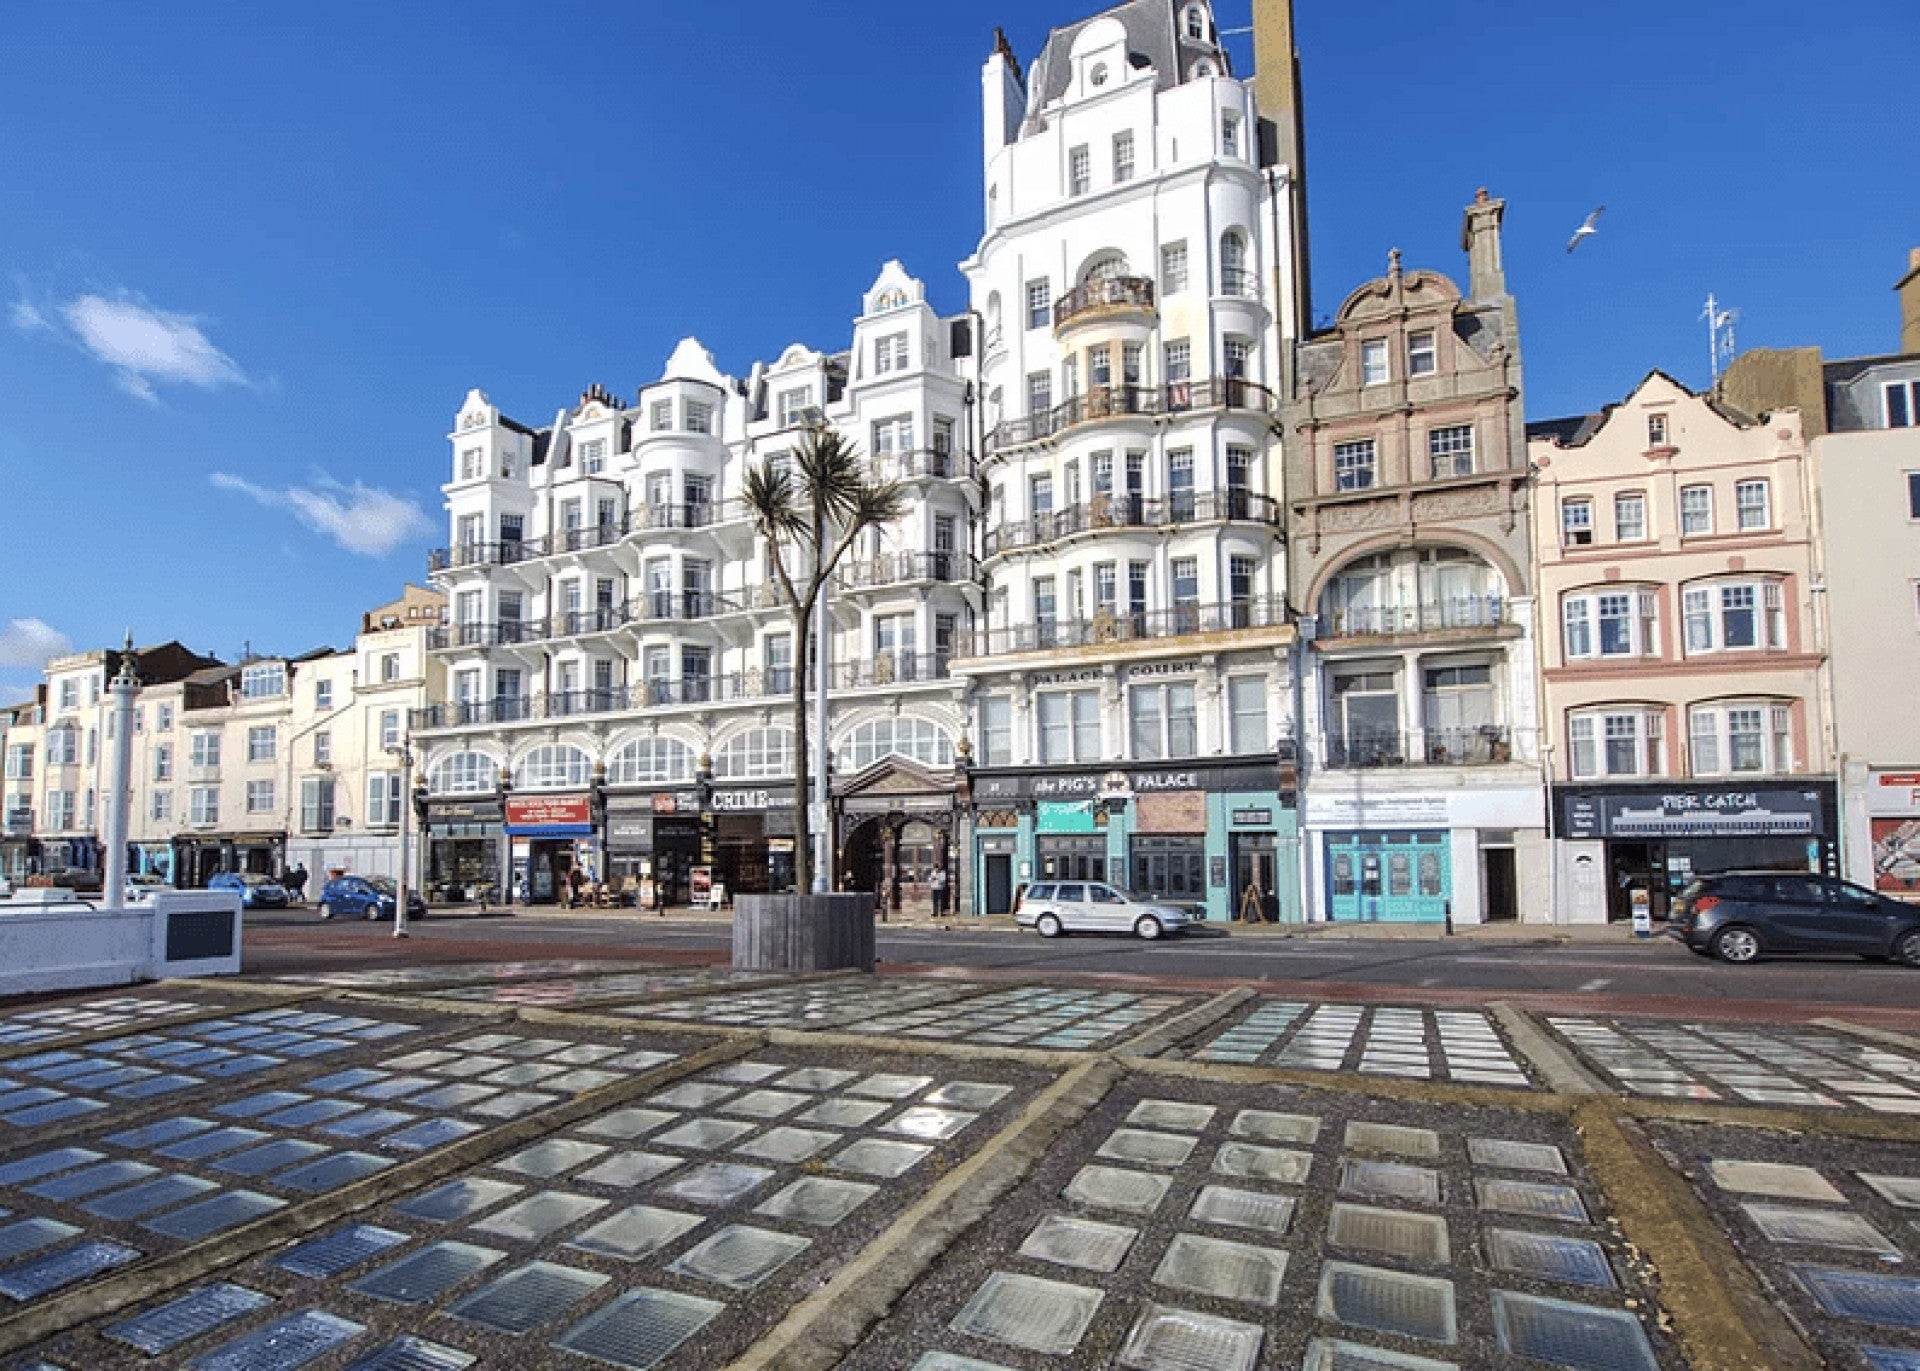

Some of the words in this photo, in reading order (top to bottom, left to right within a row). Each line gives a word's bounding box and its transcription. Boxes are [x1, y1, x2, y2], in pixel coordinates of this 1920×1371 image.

[1034, 670, 1102, 684] PALACE
[1129, 660, 1197, 676] COURT
[1035, 779, 1055, 792] the
[1058, 777, 1096, 791] PIG'S
[1137, 774, 1198, 788] PALACE
[713, 790, 768, 809] CRIME
[1662, 795, 1700, 809] PIER
[1705, 794, 1758, 808] CATCH
